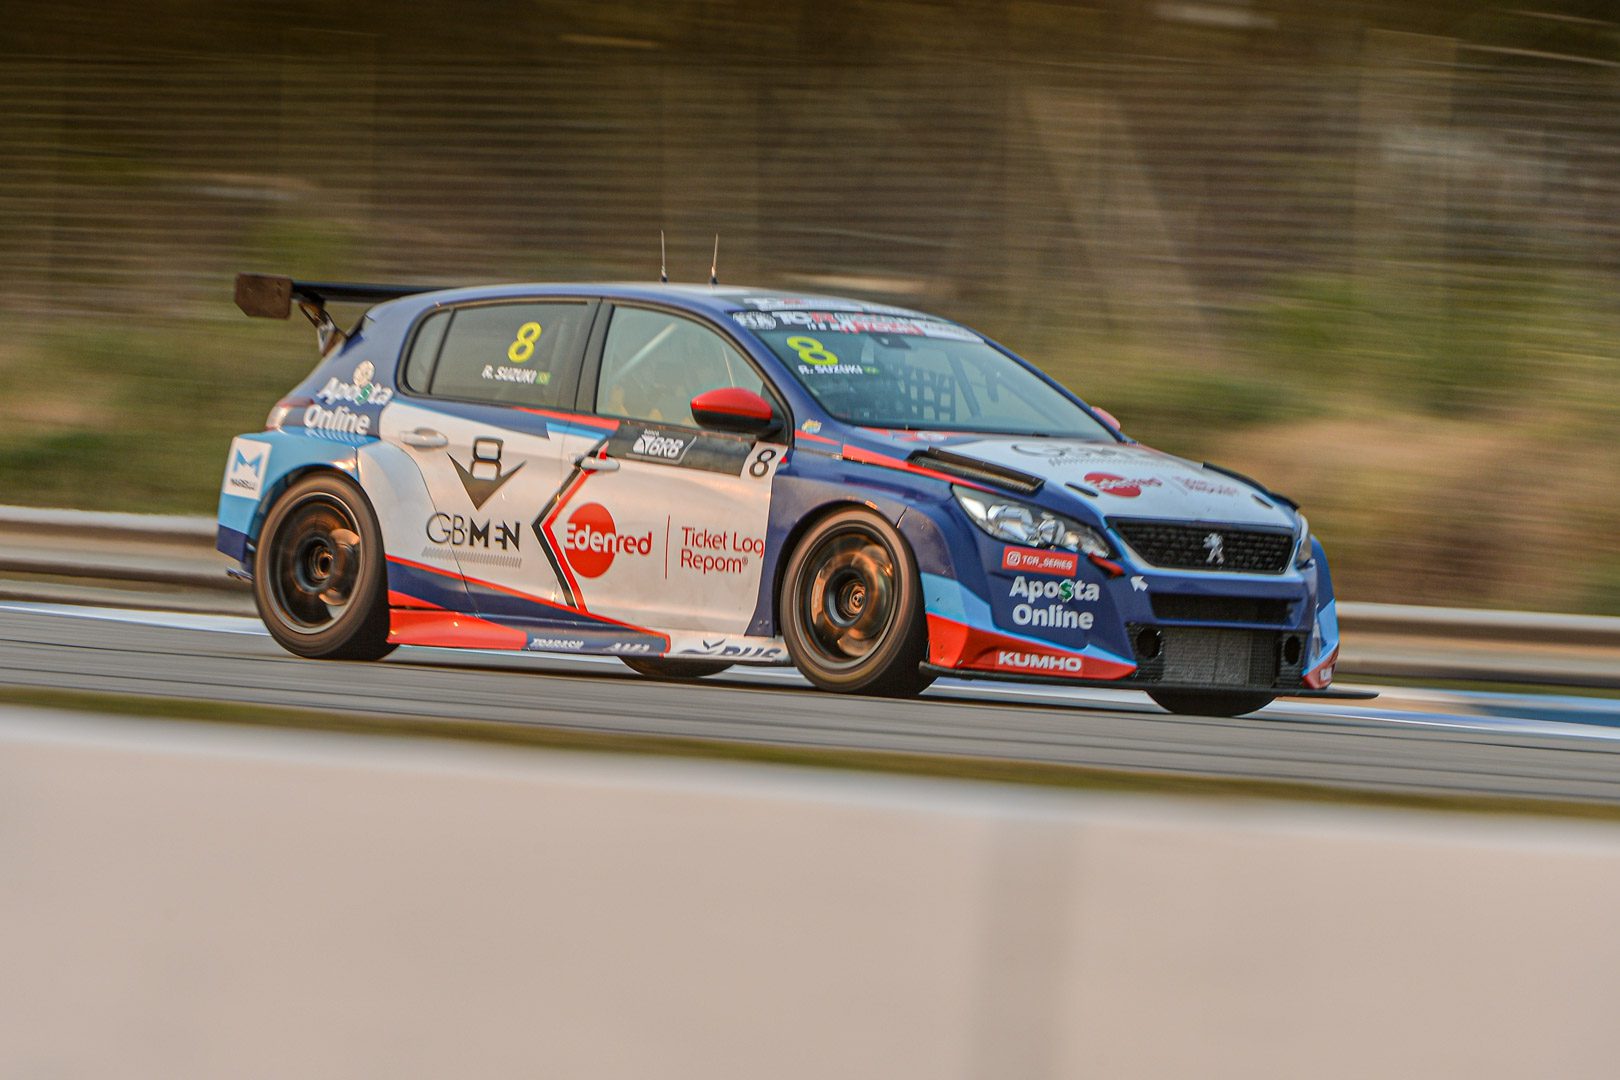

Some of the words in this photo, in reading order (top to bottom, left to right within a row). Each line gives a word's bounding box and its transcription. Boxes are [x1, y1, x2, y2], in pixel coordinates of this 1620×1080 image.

[508, 321, 543, 363] 8
[786, 335, 839, 367] 8
[494, 366, 537, 384] SUZUKI
[303, 404, 371, 436] Online
[750, 449, 777, 478] 8
[564, 523, 653, 556] Edenred
[681, 526, 728, 551] Ticket
[732, 532, 765, 558] Log
[1012, 603, 1095, 630] Online
[998, 651, 1083, 672] KUMHO
